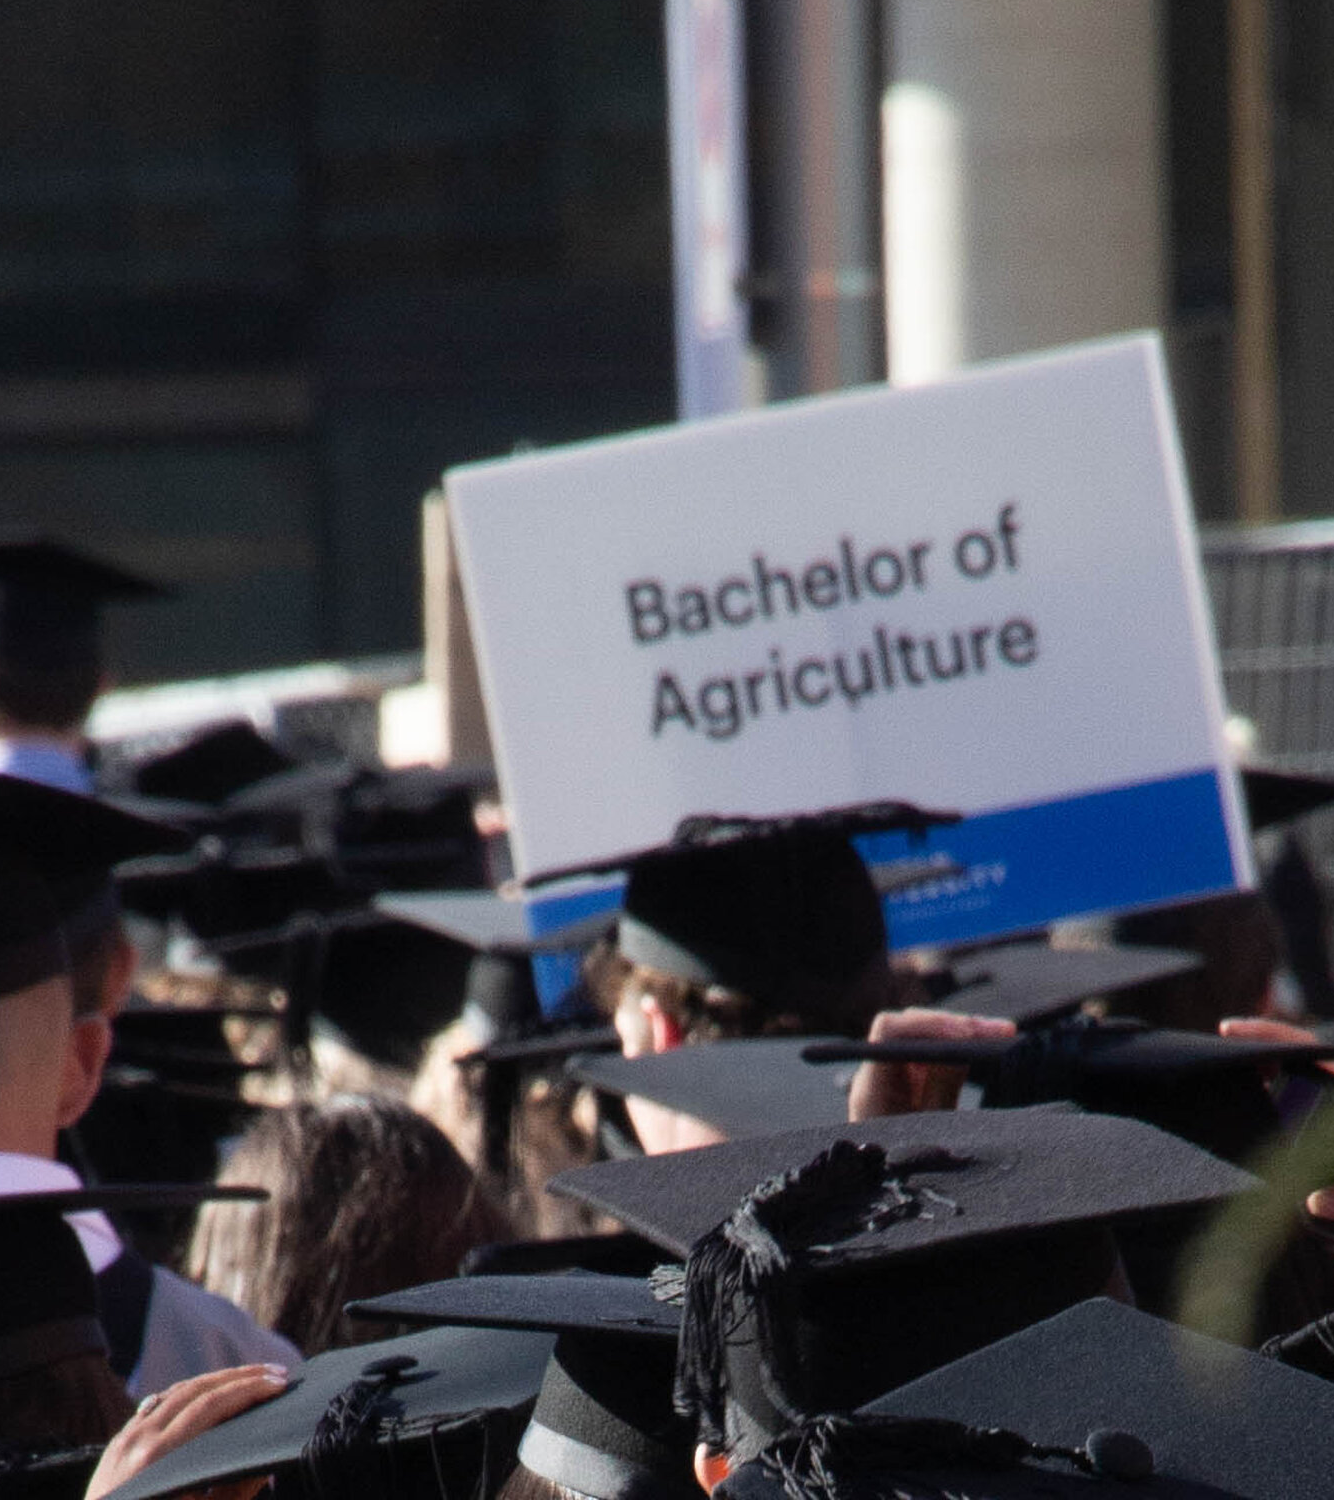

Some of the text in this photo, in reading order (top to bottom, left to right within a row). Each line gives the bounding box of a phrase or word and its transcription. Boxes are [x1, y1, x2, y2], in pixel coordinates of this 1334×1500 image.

[624, 503, 1021, 644] Bachelor of
[649, 613, 1040, 742] Agriculture
